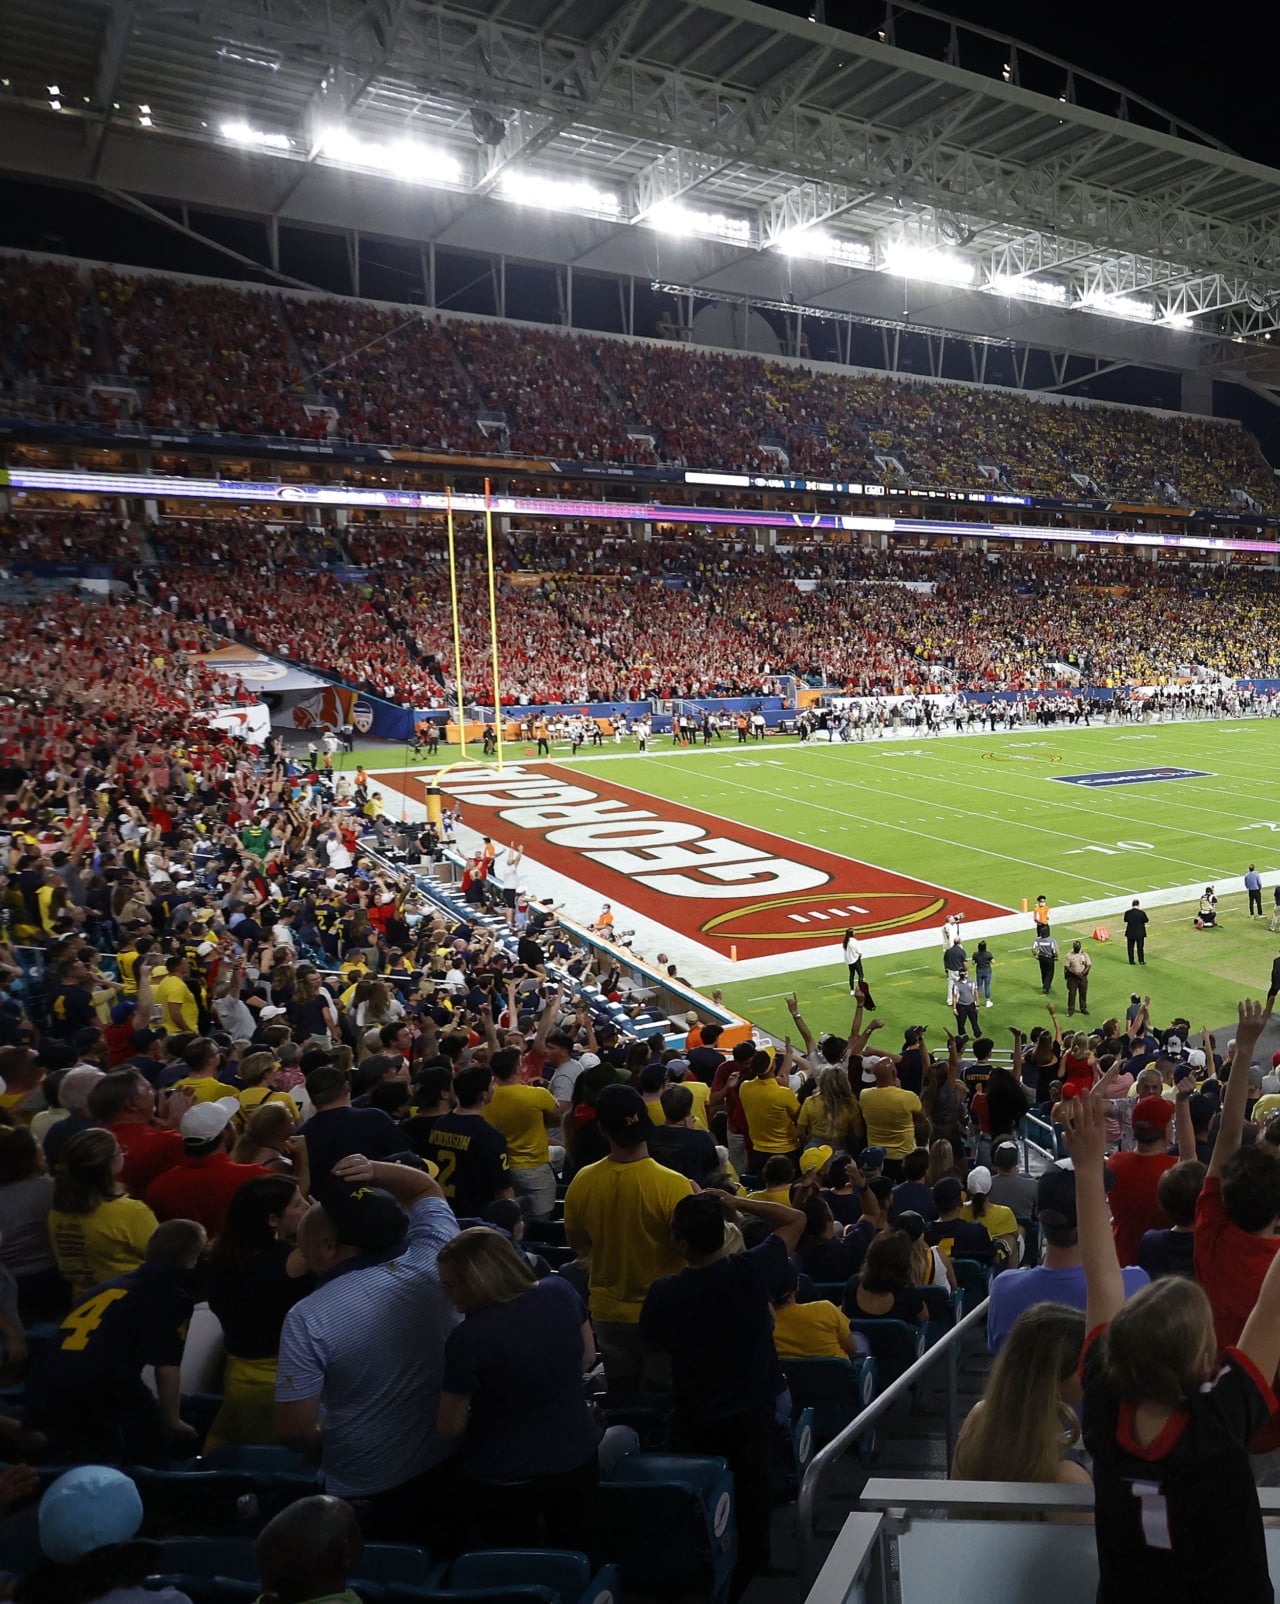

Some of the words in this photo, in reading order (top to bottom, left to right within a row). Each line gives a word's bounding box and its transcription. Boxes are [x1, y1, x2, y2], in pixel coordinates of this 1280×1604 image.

[413, 763, 832, 899] GEORGIA
[1079, 839, 1156, 856] 10
[437, 1148, 457, 1199] 2
[499, 1153, 510, 1172] 2
[60, 1287, 129, 1351] 4
